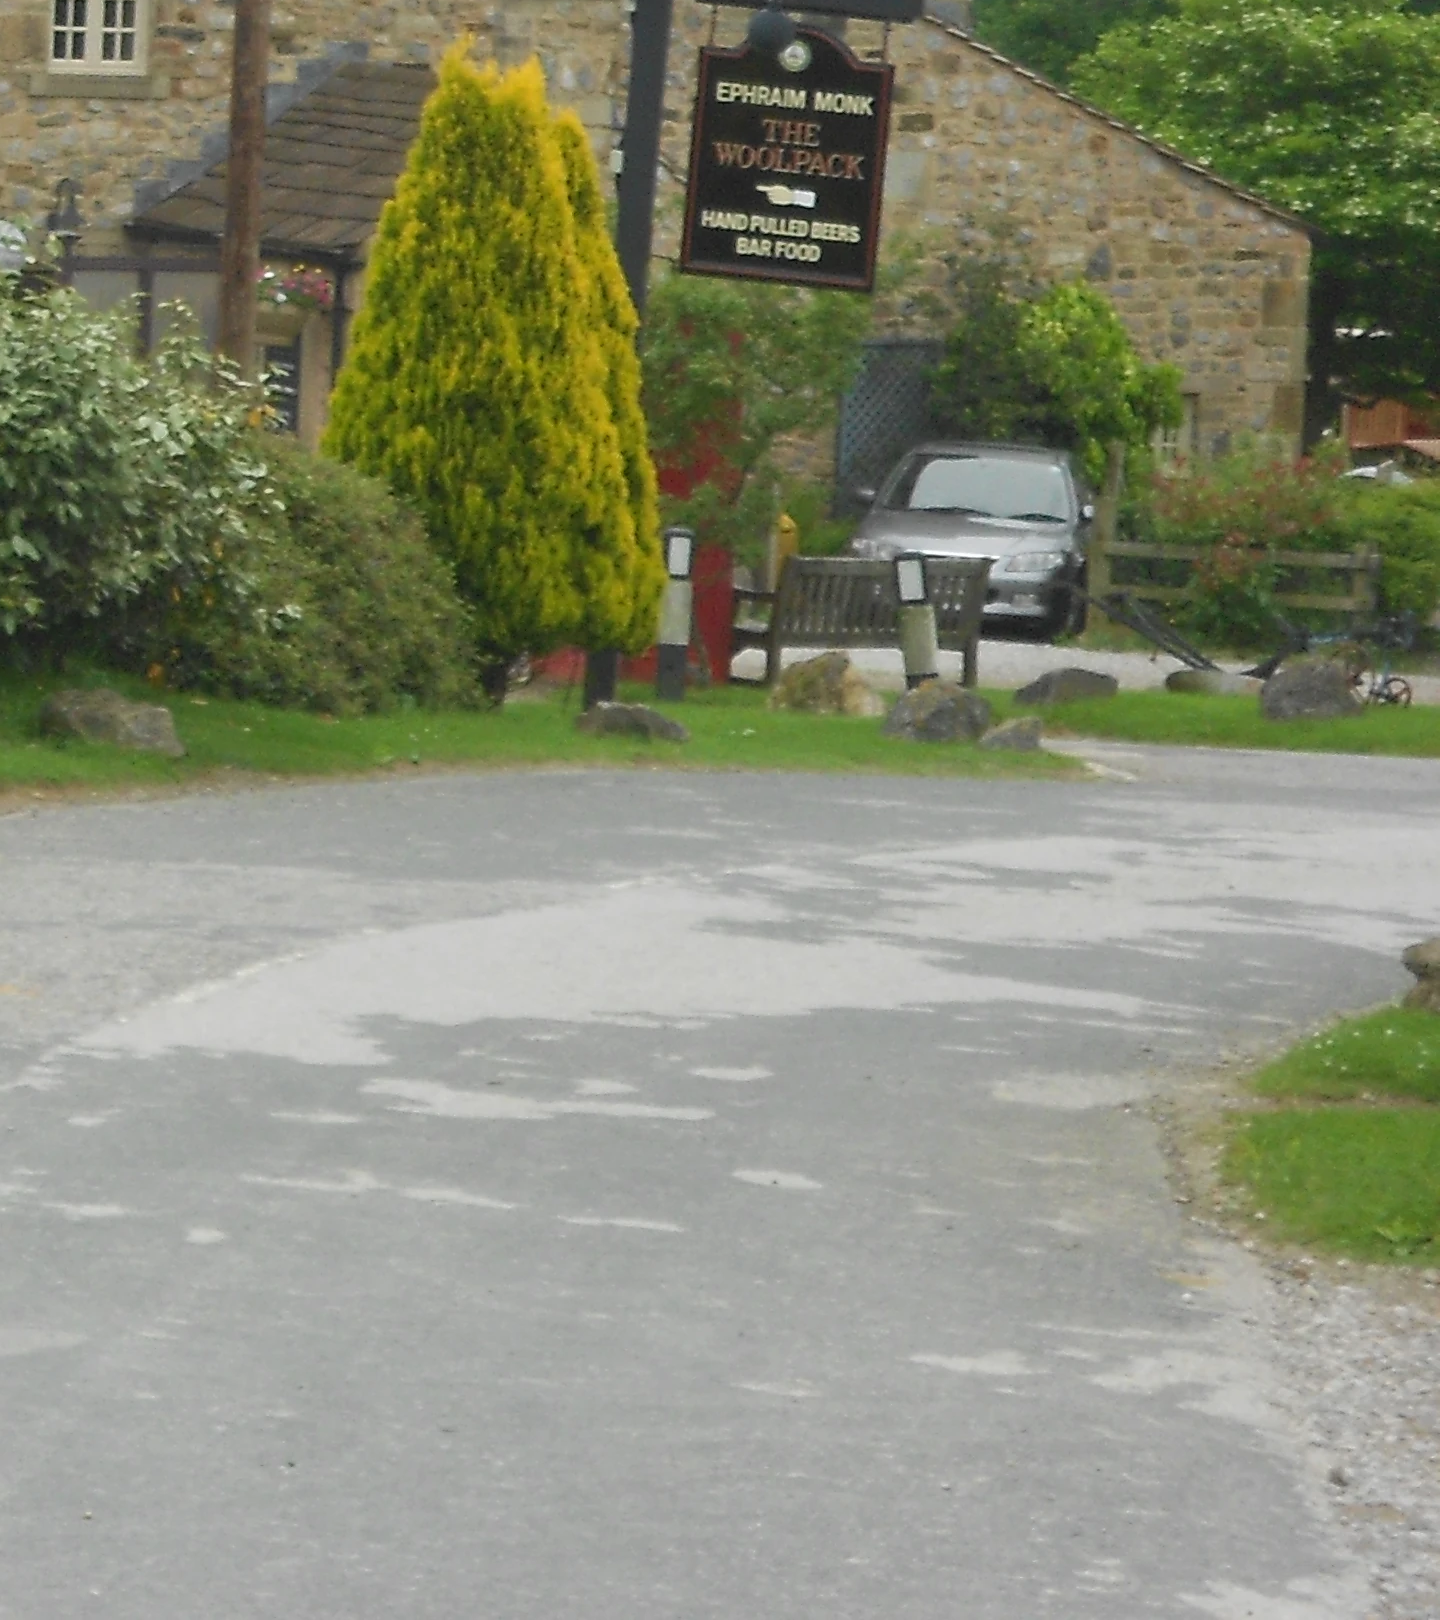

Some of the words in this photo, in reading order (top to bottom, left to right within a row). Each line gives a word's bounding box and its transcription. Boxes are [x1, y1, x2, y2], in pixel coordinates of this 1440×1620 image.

[716, 82, 806, 109] EPHRAIM
[814, 91, 874, 116] MONK
[762, 119, 821, 147] THE
[712, 142, 865, 180] WOOLPACK
[701, 210, 748, 231] HAND
[750, 215, 809, 237] PULLED
[810, 221, 861, 243] BEERS
[735, 236, 772, 257] BAR
[775, 240, 822, 263] FOOD
